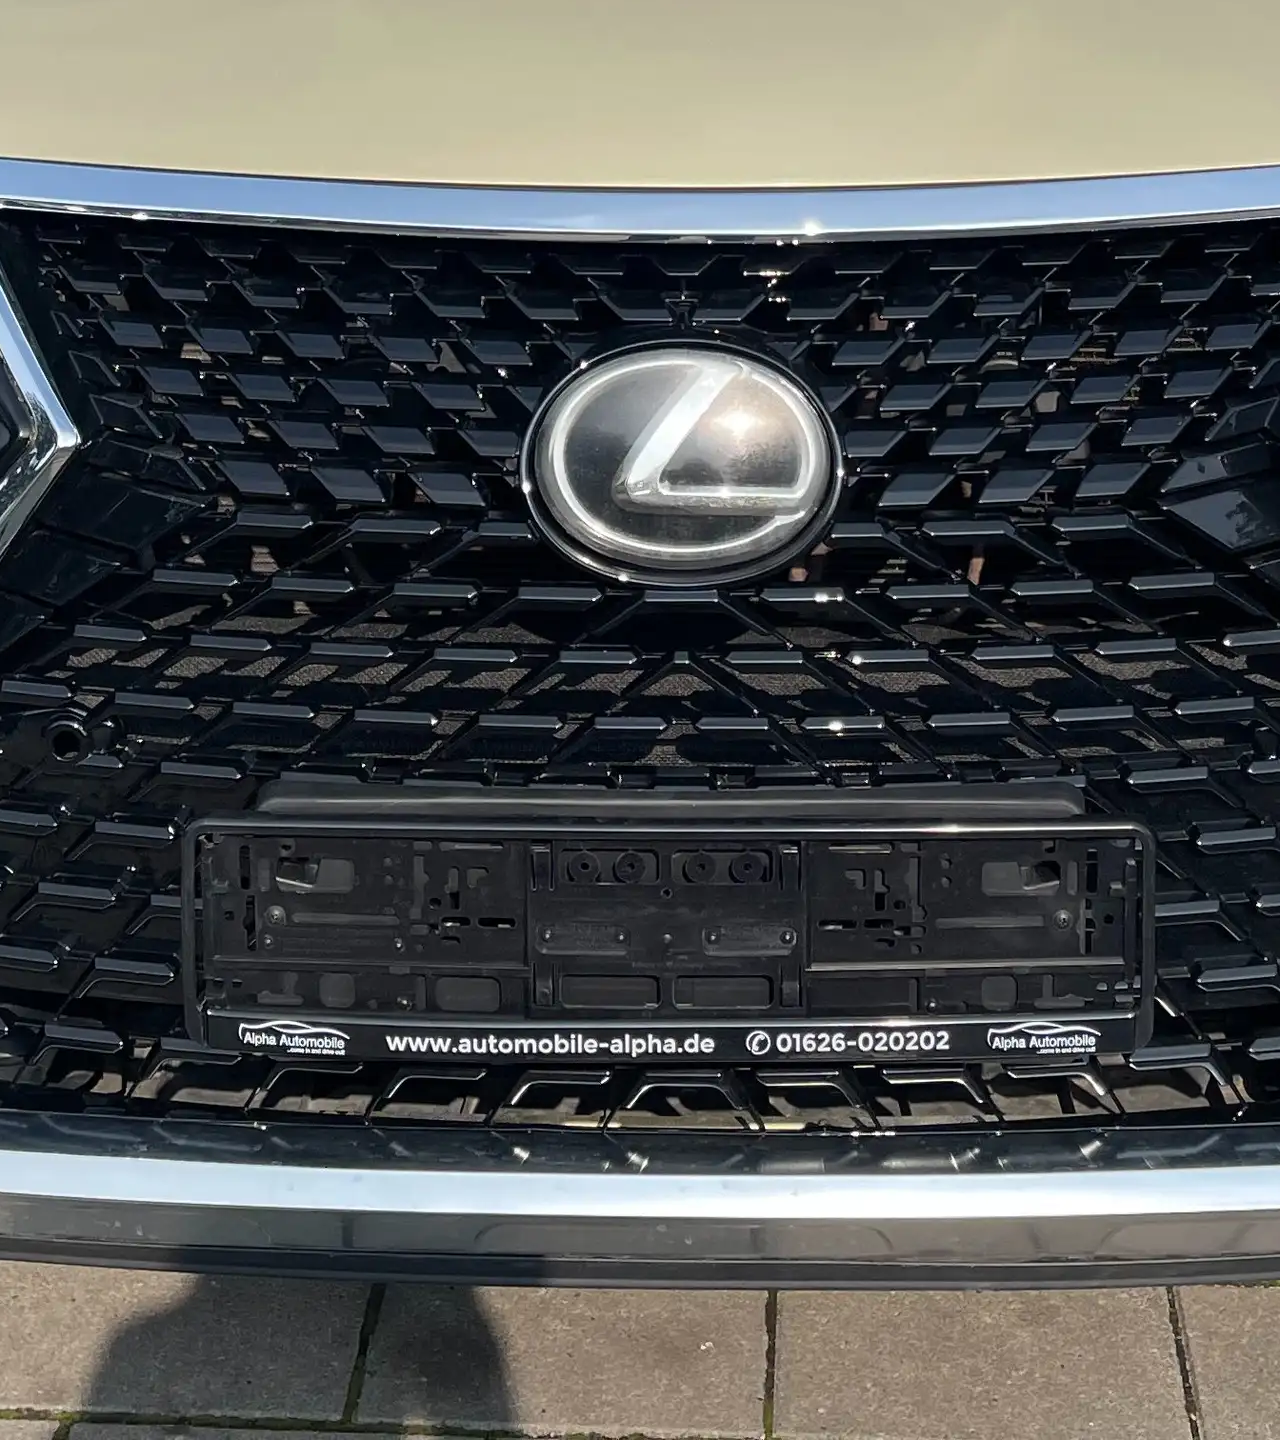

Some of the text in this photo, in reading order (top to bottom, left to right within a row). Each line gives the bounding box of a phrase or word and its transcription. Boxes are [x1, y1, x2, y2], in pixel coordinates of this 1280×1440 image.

[243, 1031, 345, 1050] Alpha Automobile
[385, 1033, 715, 1058] www.automobile-alpha.de
[776, 1030, 950, 1053] 01626-020202
[991, 1034, 1096, 1051] Alpha Automobile
